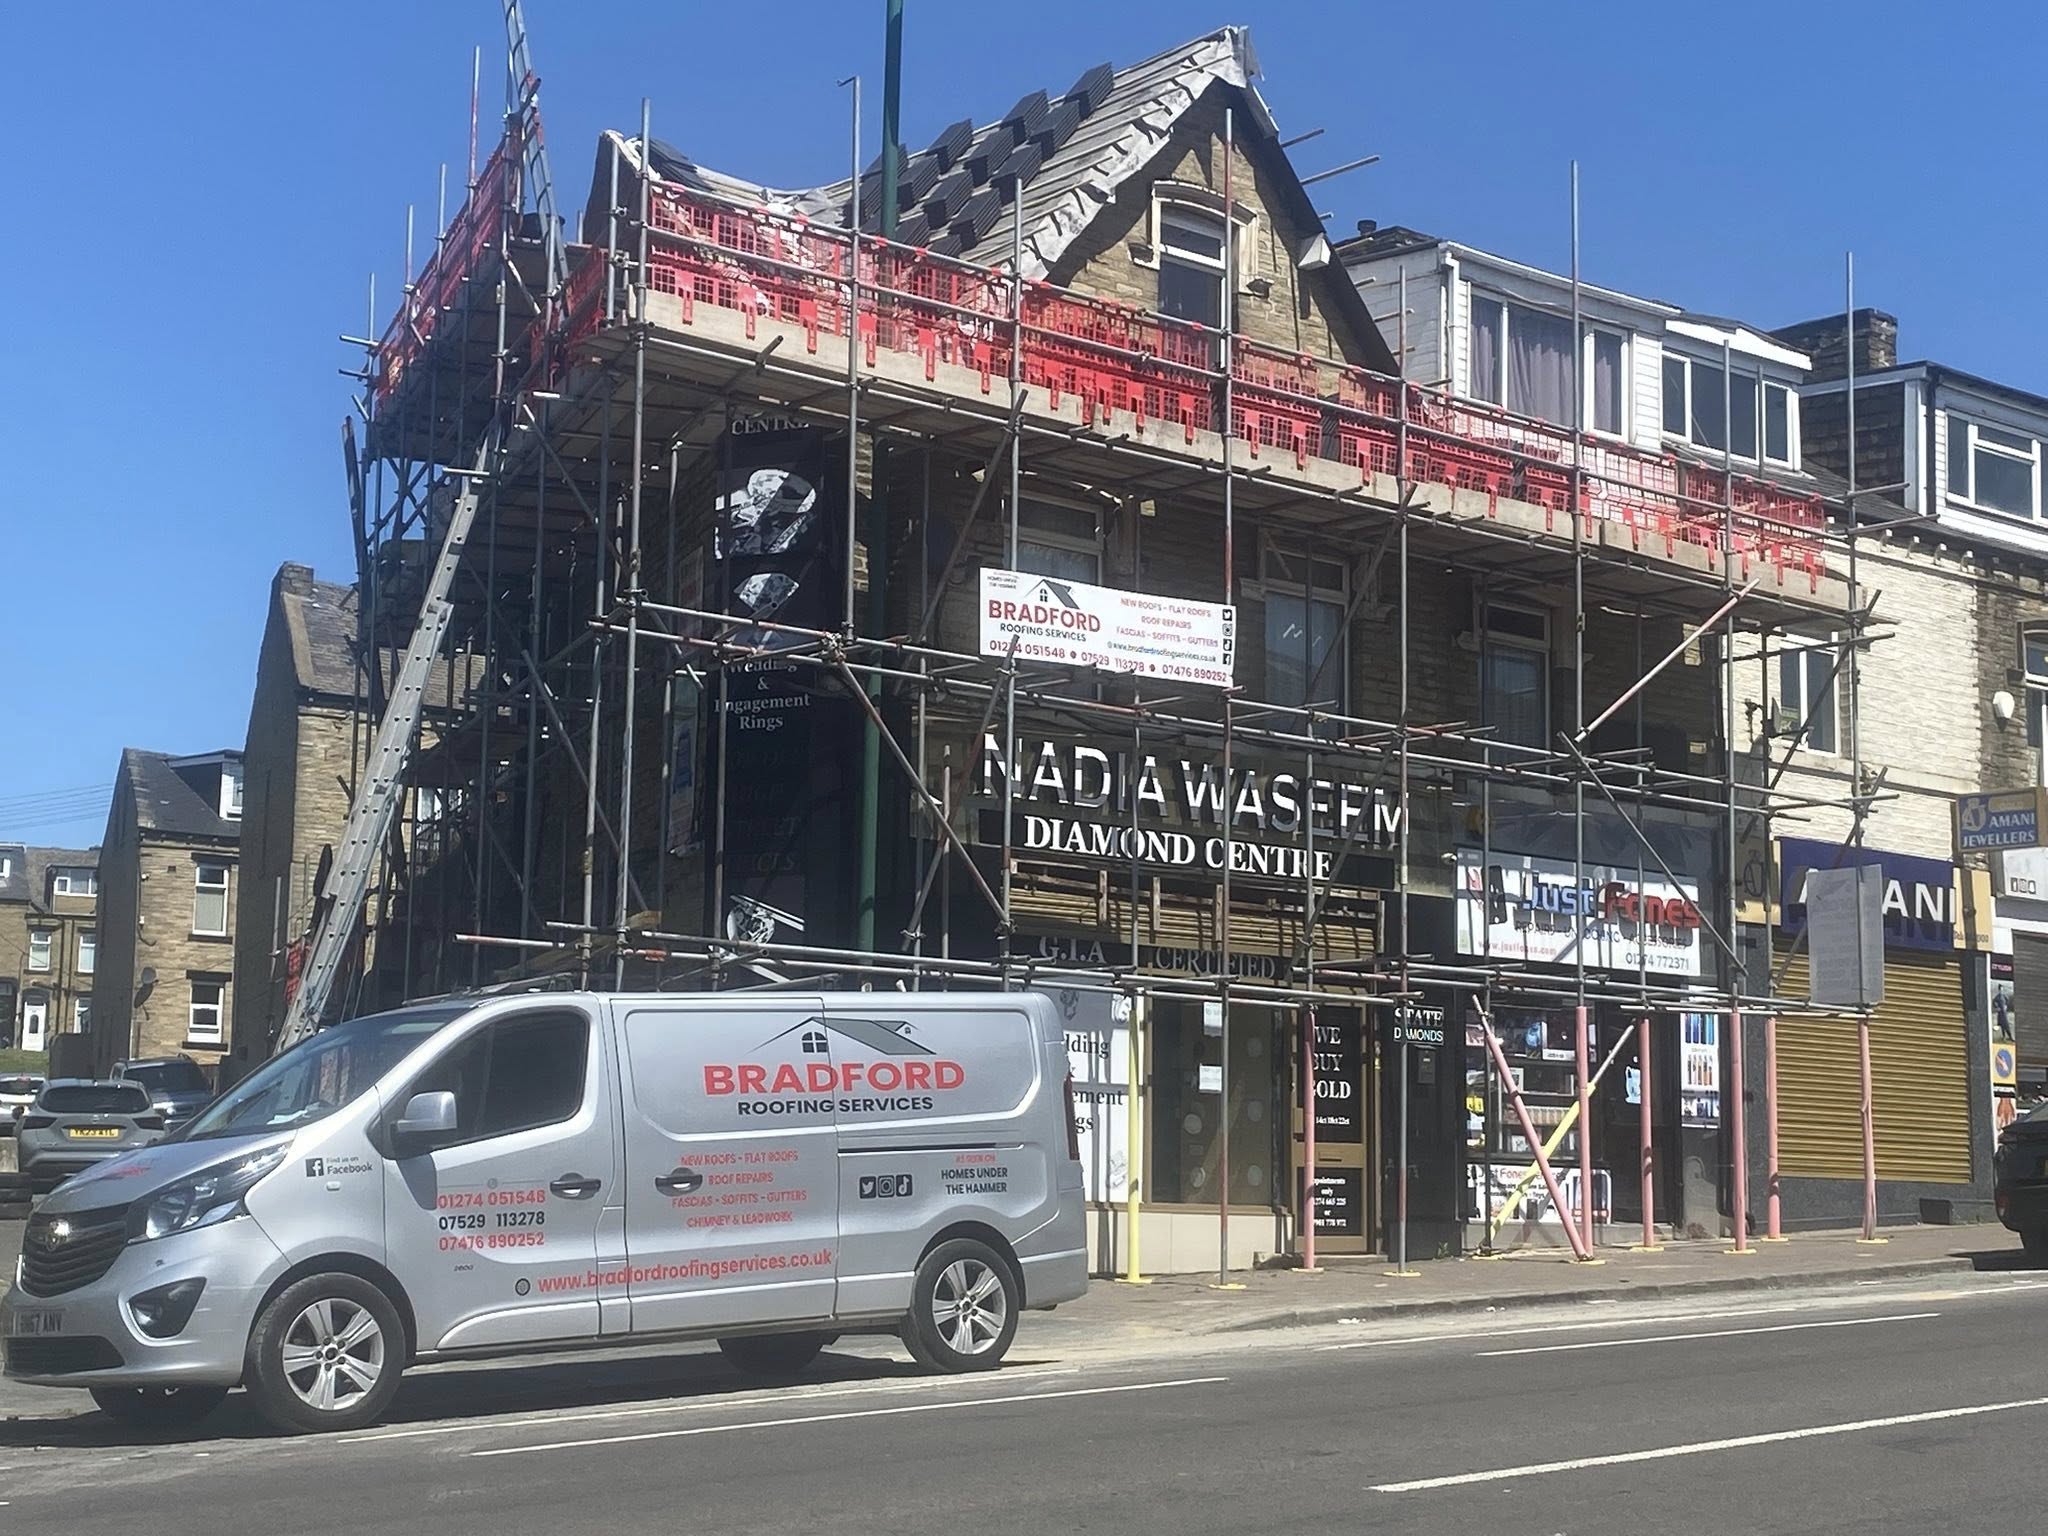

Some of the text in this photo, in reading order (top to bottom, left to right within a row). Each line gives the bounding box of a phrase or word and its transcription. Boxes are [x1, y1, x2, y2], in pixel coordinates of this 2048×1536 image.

[988, 599, 1101, 632] BRADFORD
[1121, 598, 1137, 607] NEW
[1138, 601, 1162, 611] ROOFS
[1168, 605, 1186, 614] FLAT
[1187, 607, 1211, 617] ROOFS
[1141, 616, 1192, 629] ROOF REPAIRS
[1000, 623, 1086, 642] ROOFING SERVICES
[1116, 626, 1145, 638] FASCIAS
[1152, 632, 1181, 642] SOFFITS
[1187, 636, 1218, 648] GUTTERS
[1025, 644, 1065, 659] 051548
[1162, 664, 1192, 677] 07476
[1193, 668, 1227, 682] 890252
[757, 676, 769, 690] &
[740, 715, 783, 731] Rings
[983, 733, 1168, 816] NADIA
[1989, 813, 2035, 829] AMANI
[1024, 815, 1333, 881] DIAMOND CENTRE
[1962, 830, 2035, 848] JEWELLERS
[1156, 946, 1276, 979] CERTIFIED
[1656, 954, 1690, 970] 772371
[1315, 1027, 1341, 1044] WE
[1394, 1027, 1444, 1042] DAMONDS
[704, 1061, 965, 1096] BRADFORD
[738, 1097, 933, 1116] ROOFING SERVICES
[681, 1155, 703, 1166] NEW
[704, 1154, 736, 1165] ROOFS
[744, 1152, 766, 1163] FLAT
[767, 1150, 799, 1162] ROOFS
[327, 1161, 373, 1174] Facebook
[941, 1167, 1008, 1180] HOMES UNDER
[708, 1171, 774, 1185] ROOF REPAIRS
[945, 1182, 1007, 1195] THE HAMMER
[438, 1189, 545, 1209] 01274 051548
[672, 1195, 712, 1208] FASCIAS
[721, 1192, 758, 1205] SOFFITS
[767, 1190, 808, 1202] GUTTERS
[439, 1211, 545, 1230] 07529 113278
[686, 1211, 793, 1228] CHIMNEY & LEADWORK
[439, 1232, 545, 1251] 07476 890252
[538, 1248, 832, 1293] www.bradfordroofingservices.co.uk
